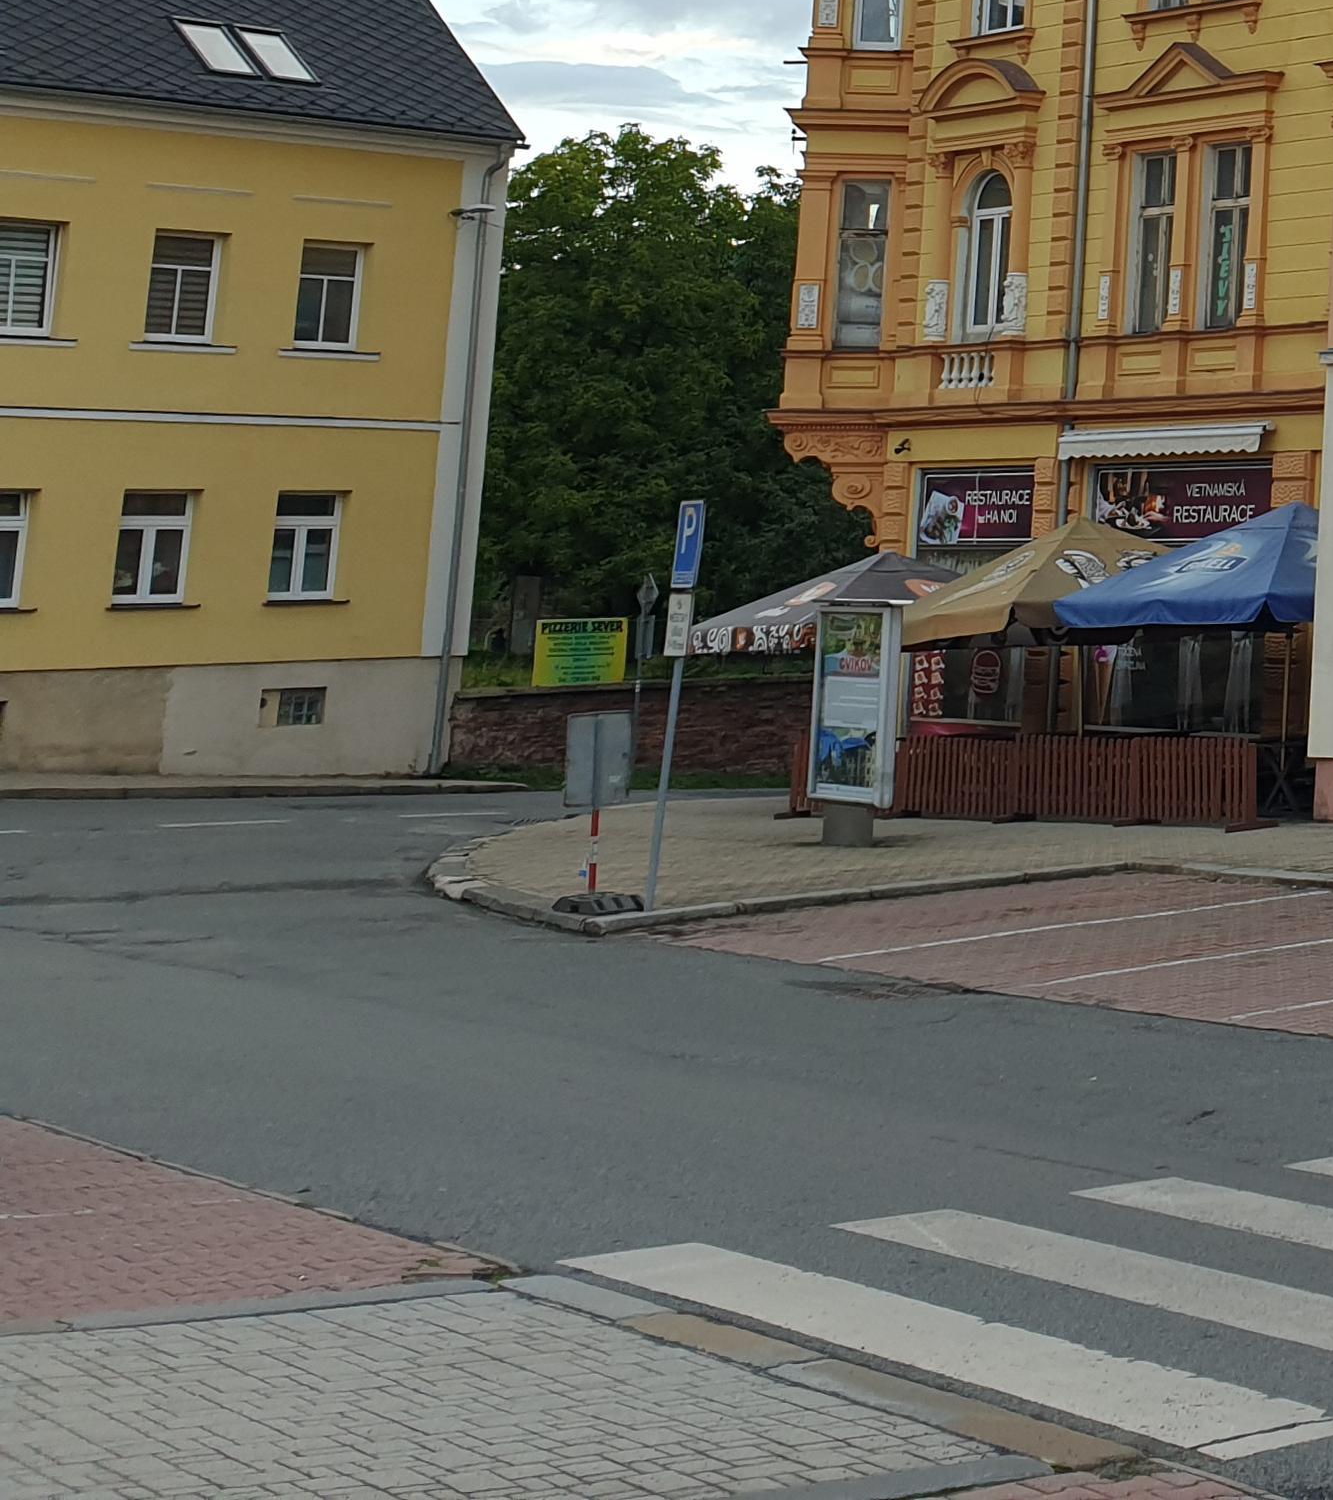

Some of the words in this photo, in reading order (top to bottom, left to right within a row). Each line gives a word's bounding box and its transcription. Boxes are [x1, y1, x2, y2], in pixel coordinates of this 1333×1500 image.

[1185, 478, 1246, 498] VIETNAMSKÁ
[965, 490, 1031, 505] RESTAURACE
[985, 510, 999, 524] HA
[1000, 509, 1017, 524] NOI
[1173, 504, 1256, 523] RESTAURACE
[680, 507, 697, 554] P
[541, 621, 588, 635] PIZZERIE
[591, 620, 623, 634] SEVER
[839, 657, 875, 671] CVIKOV
